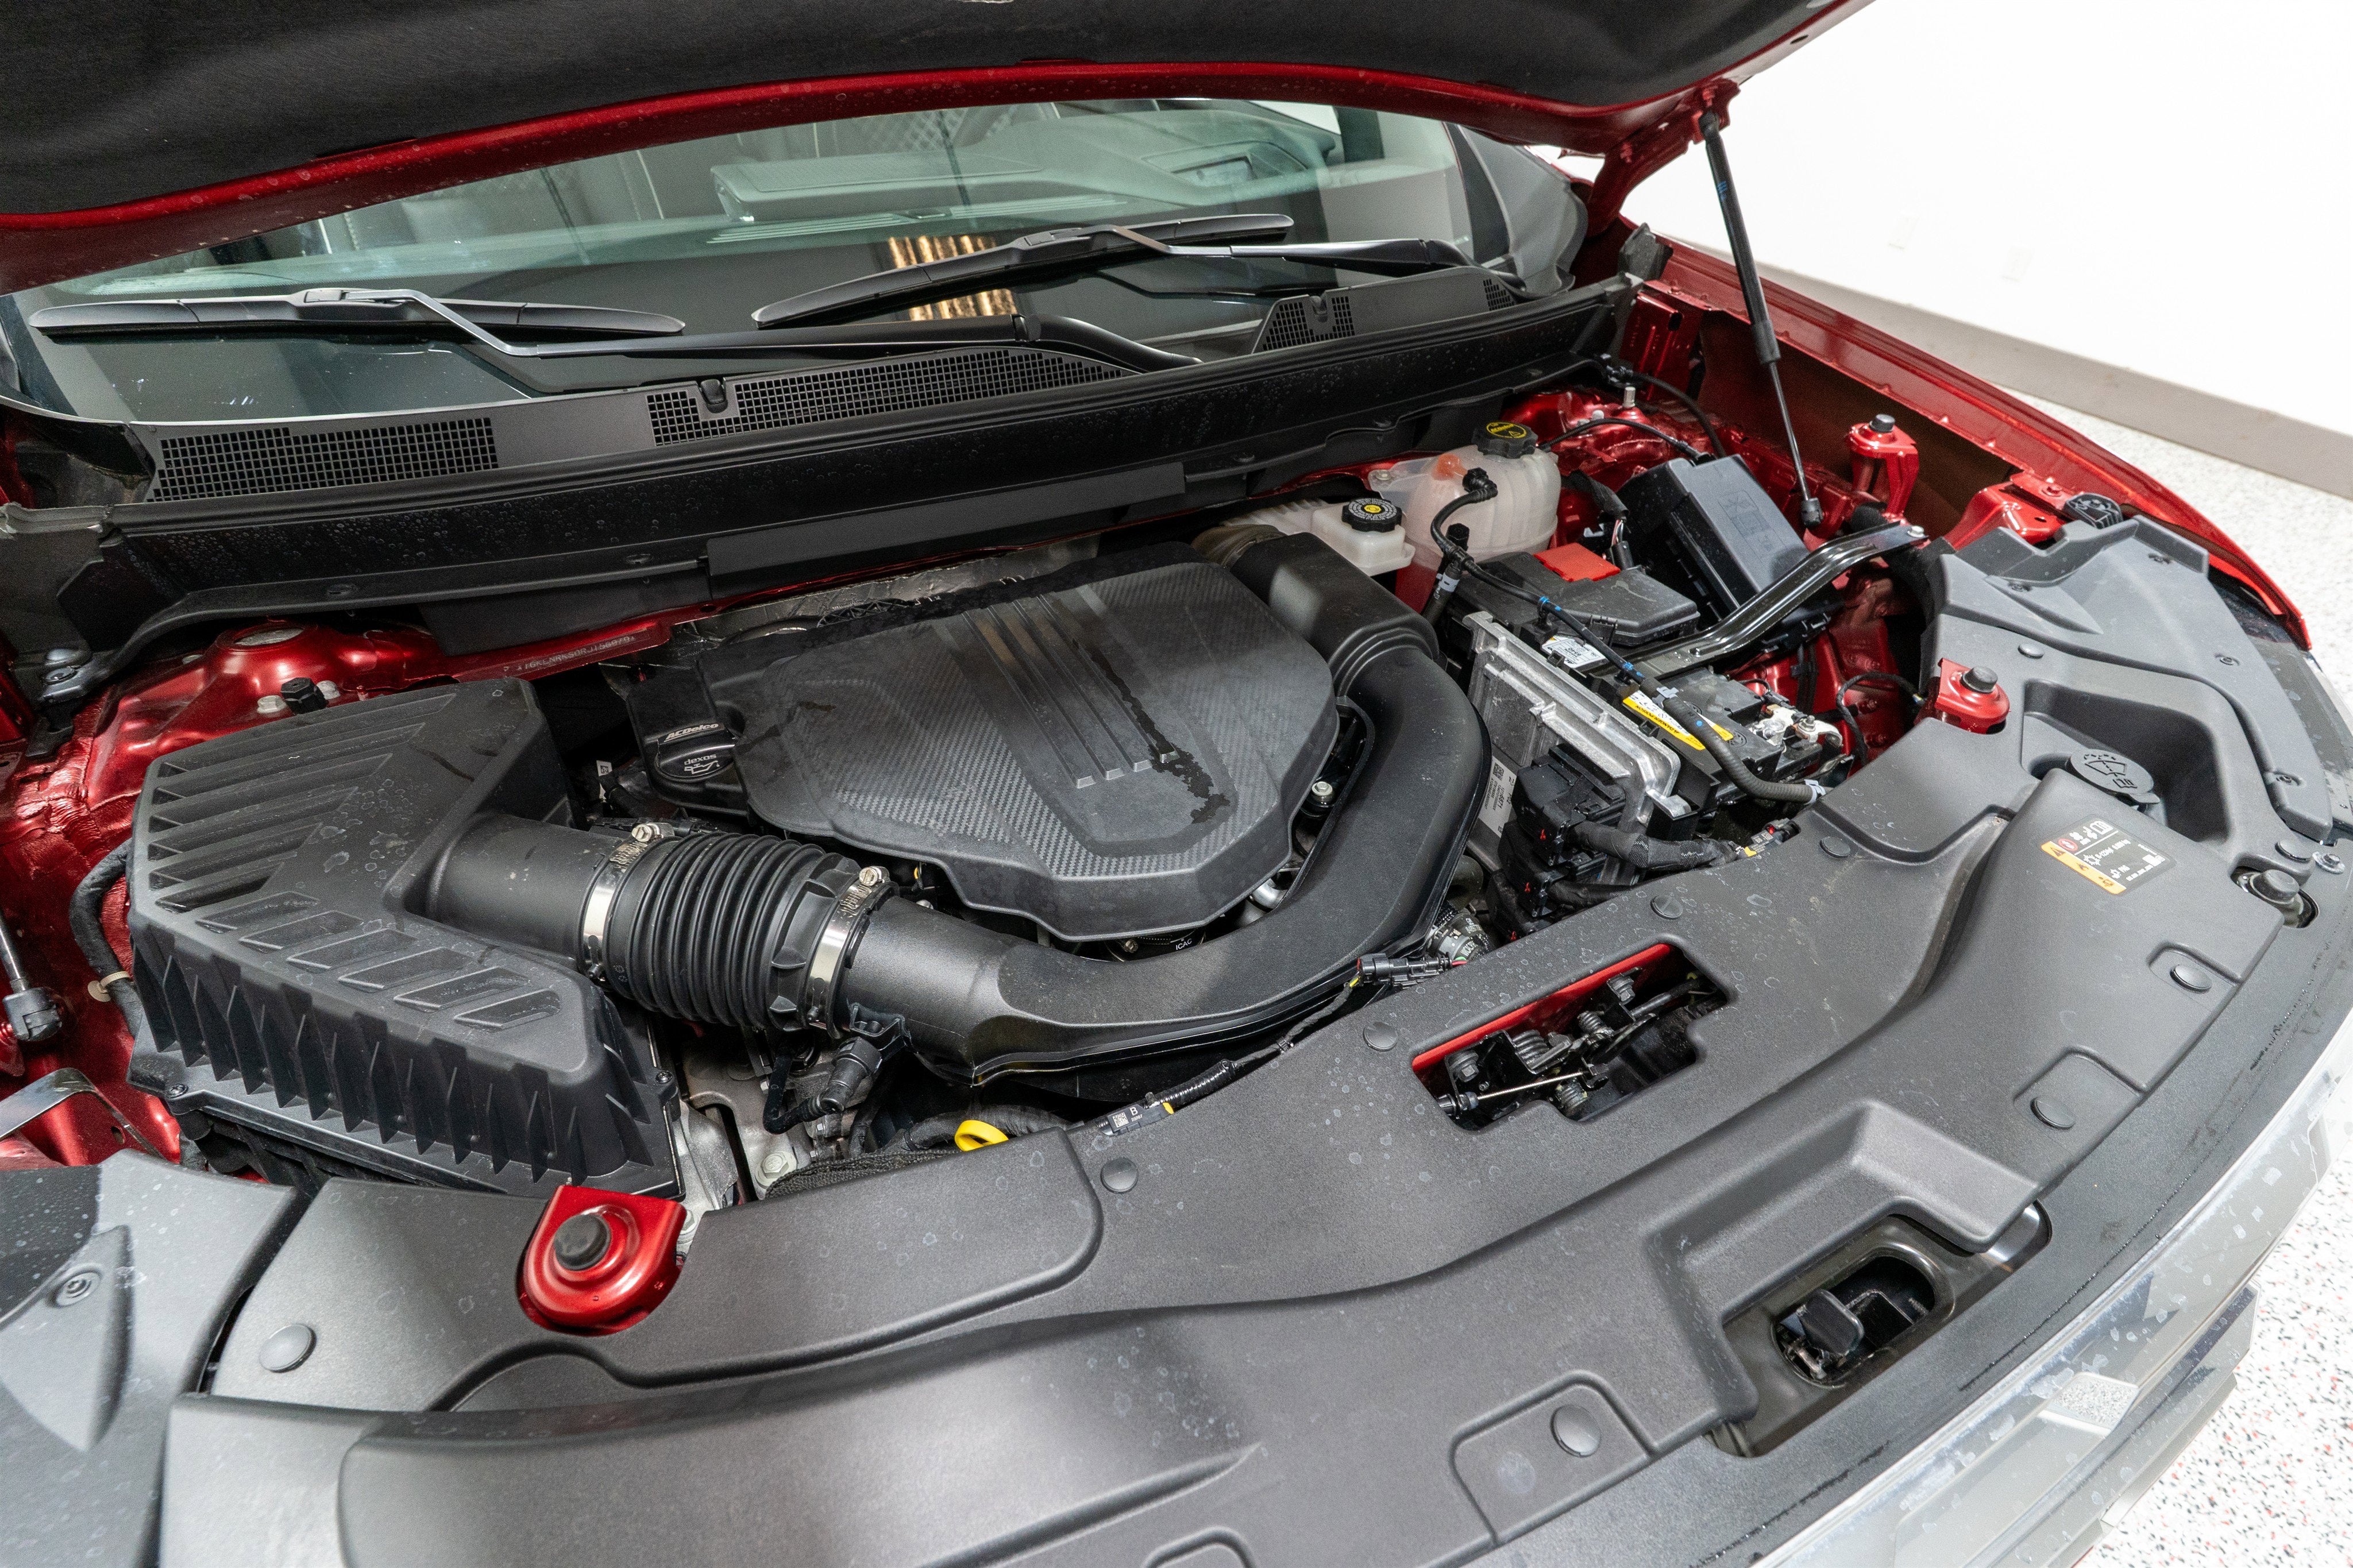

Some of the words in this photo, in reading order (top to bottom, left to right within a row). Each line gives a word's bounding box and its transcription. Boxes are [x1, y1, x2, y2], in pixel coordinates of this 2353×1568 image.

[665, 724, 719, 741] ACDelco
[684, 754, 717, 766] dexos
[1175, 939, 1192, 950] ICAC
[1129, 1106, 1138, 1116] B
